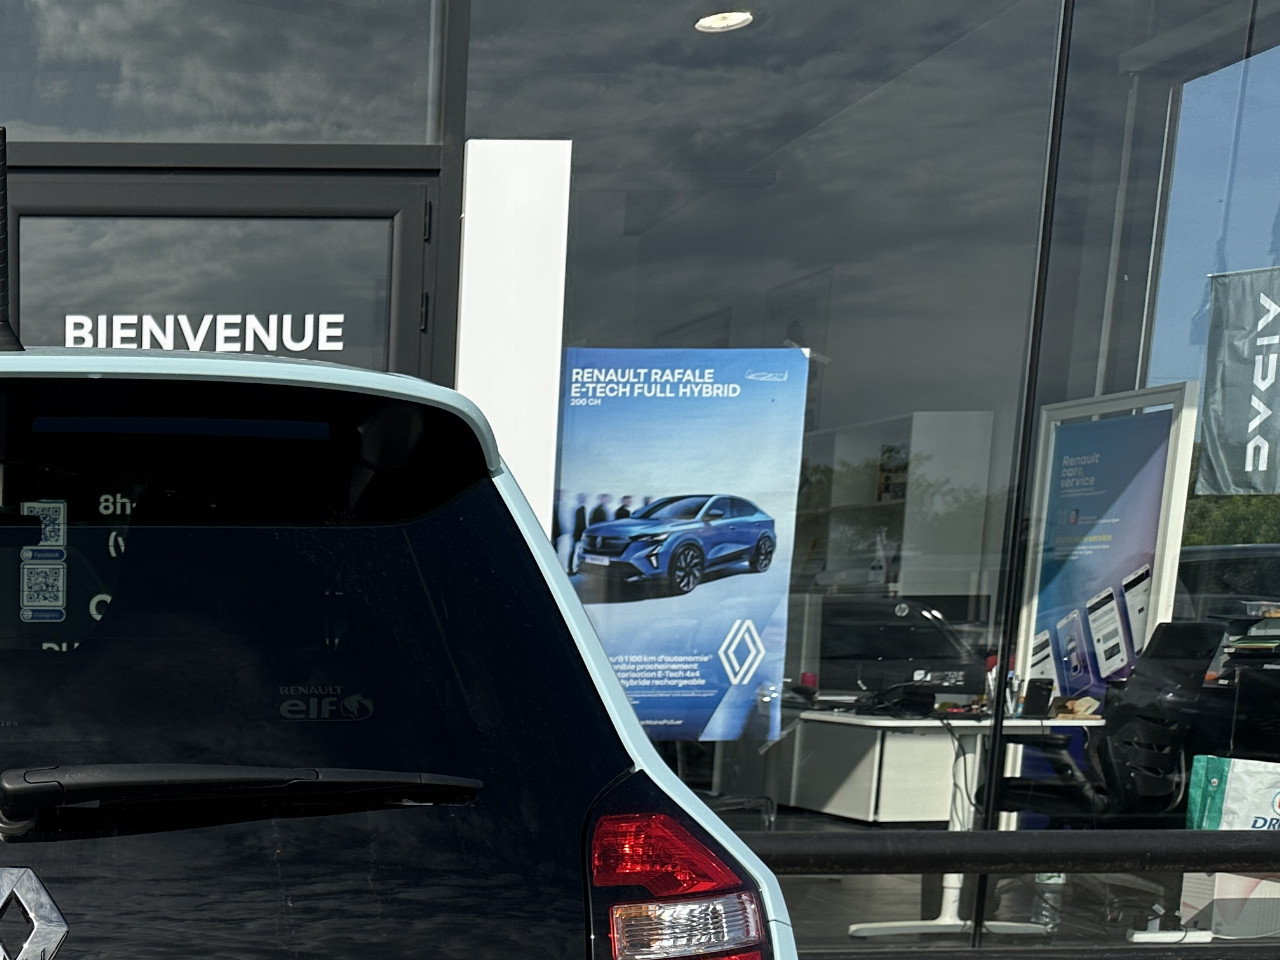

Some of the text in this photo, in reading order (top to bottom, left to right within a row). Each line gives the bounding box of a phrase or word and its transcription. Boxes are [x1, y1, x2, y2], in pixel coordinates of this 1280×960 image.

[65, 314, 344, 351] BIENVENUE
[571, 369, 715, 382] RENAULT RAFALE
[570, 383, 741, 397] E-TECH FULL HYBRID
[1063, 452, 1099, 466] Renault
[1060, 477, 1094, 488] service
[280, 686, 344, 694] RENAULT
[280, 697, 337, 719] elf
